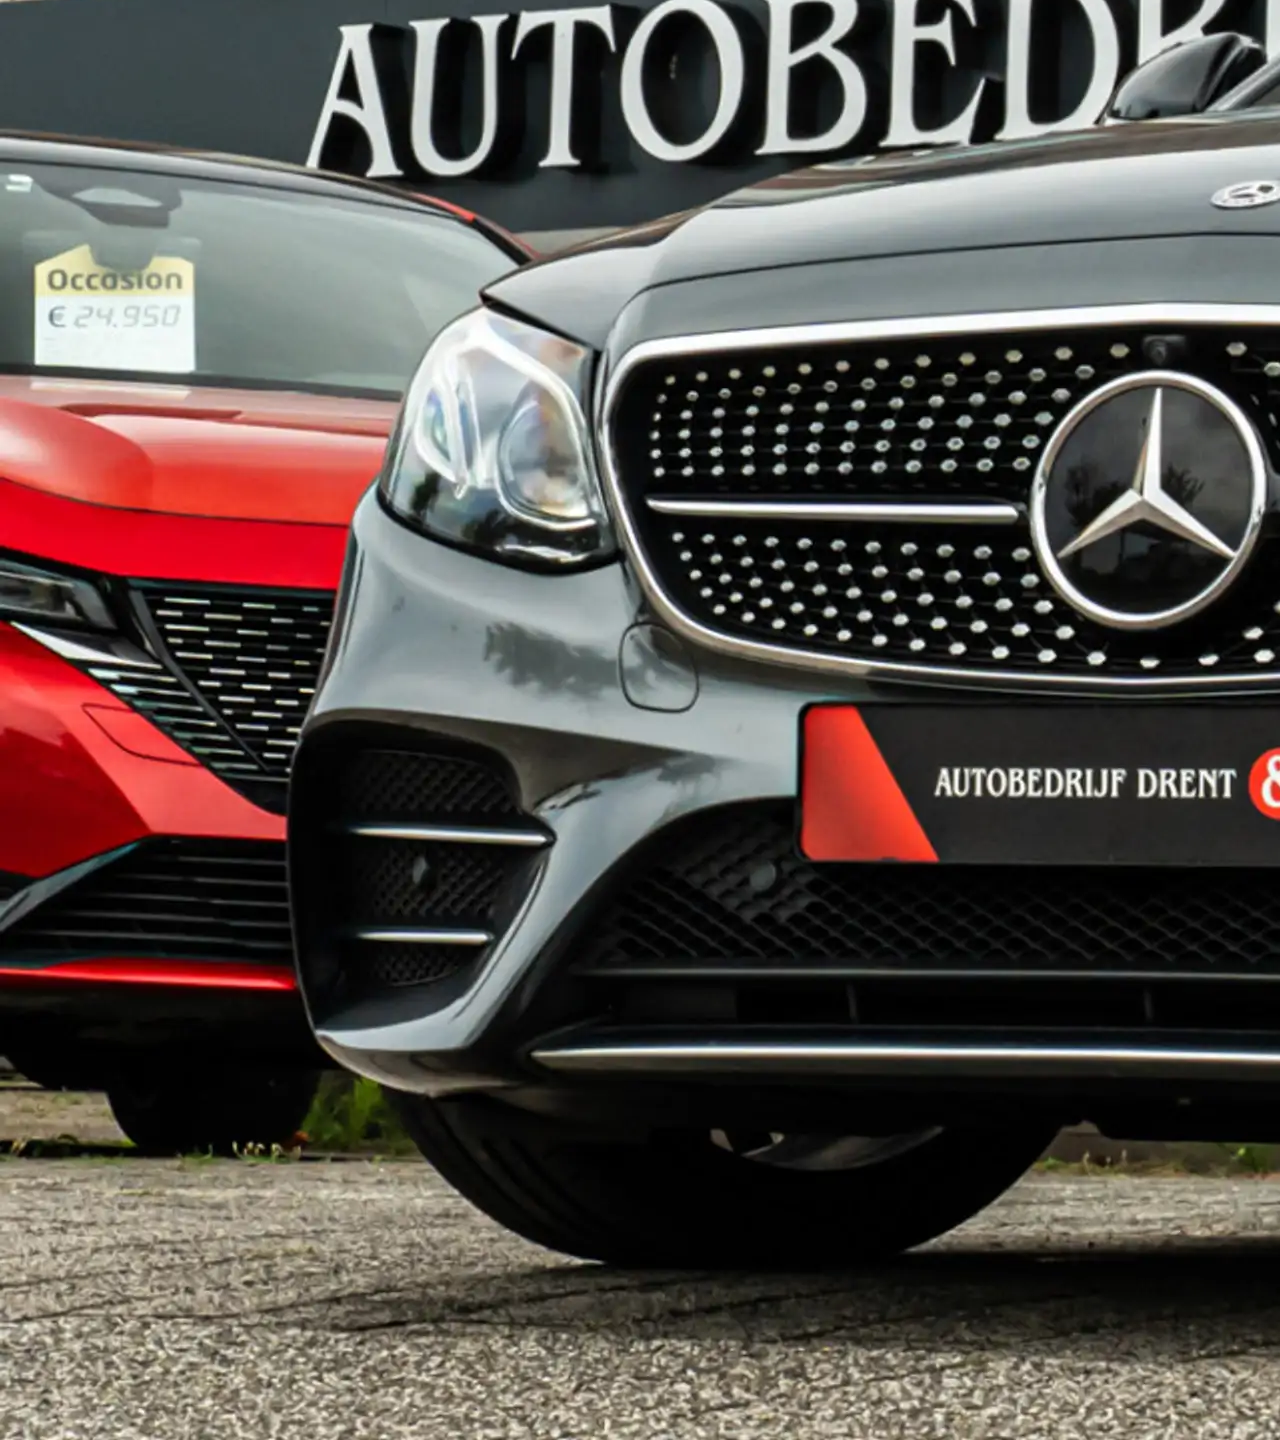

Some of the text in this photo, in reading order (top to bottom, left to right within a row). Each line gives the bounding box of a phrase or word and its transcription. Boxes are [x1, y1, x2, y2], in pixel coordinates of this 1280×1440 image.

[47, 268, 183, 291] Occasion
[934, 767, 1127, 798] AUTOBEDRIJF
[1137, 768, 1237, 799] DRENT
